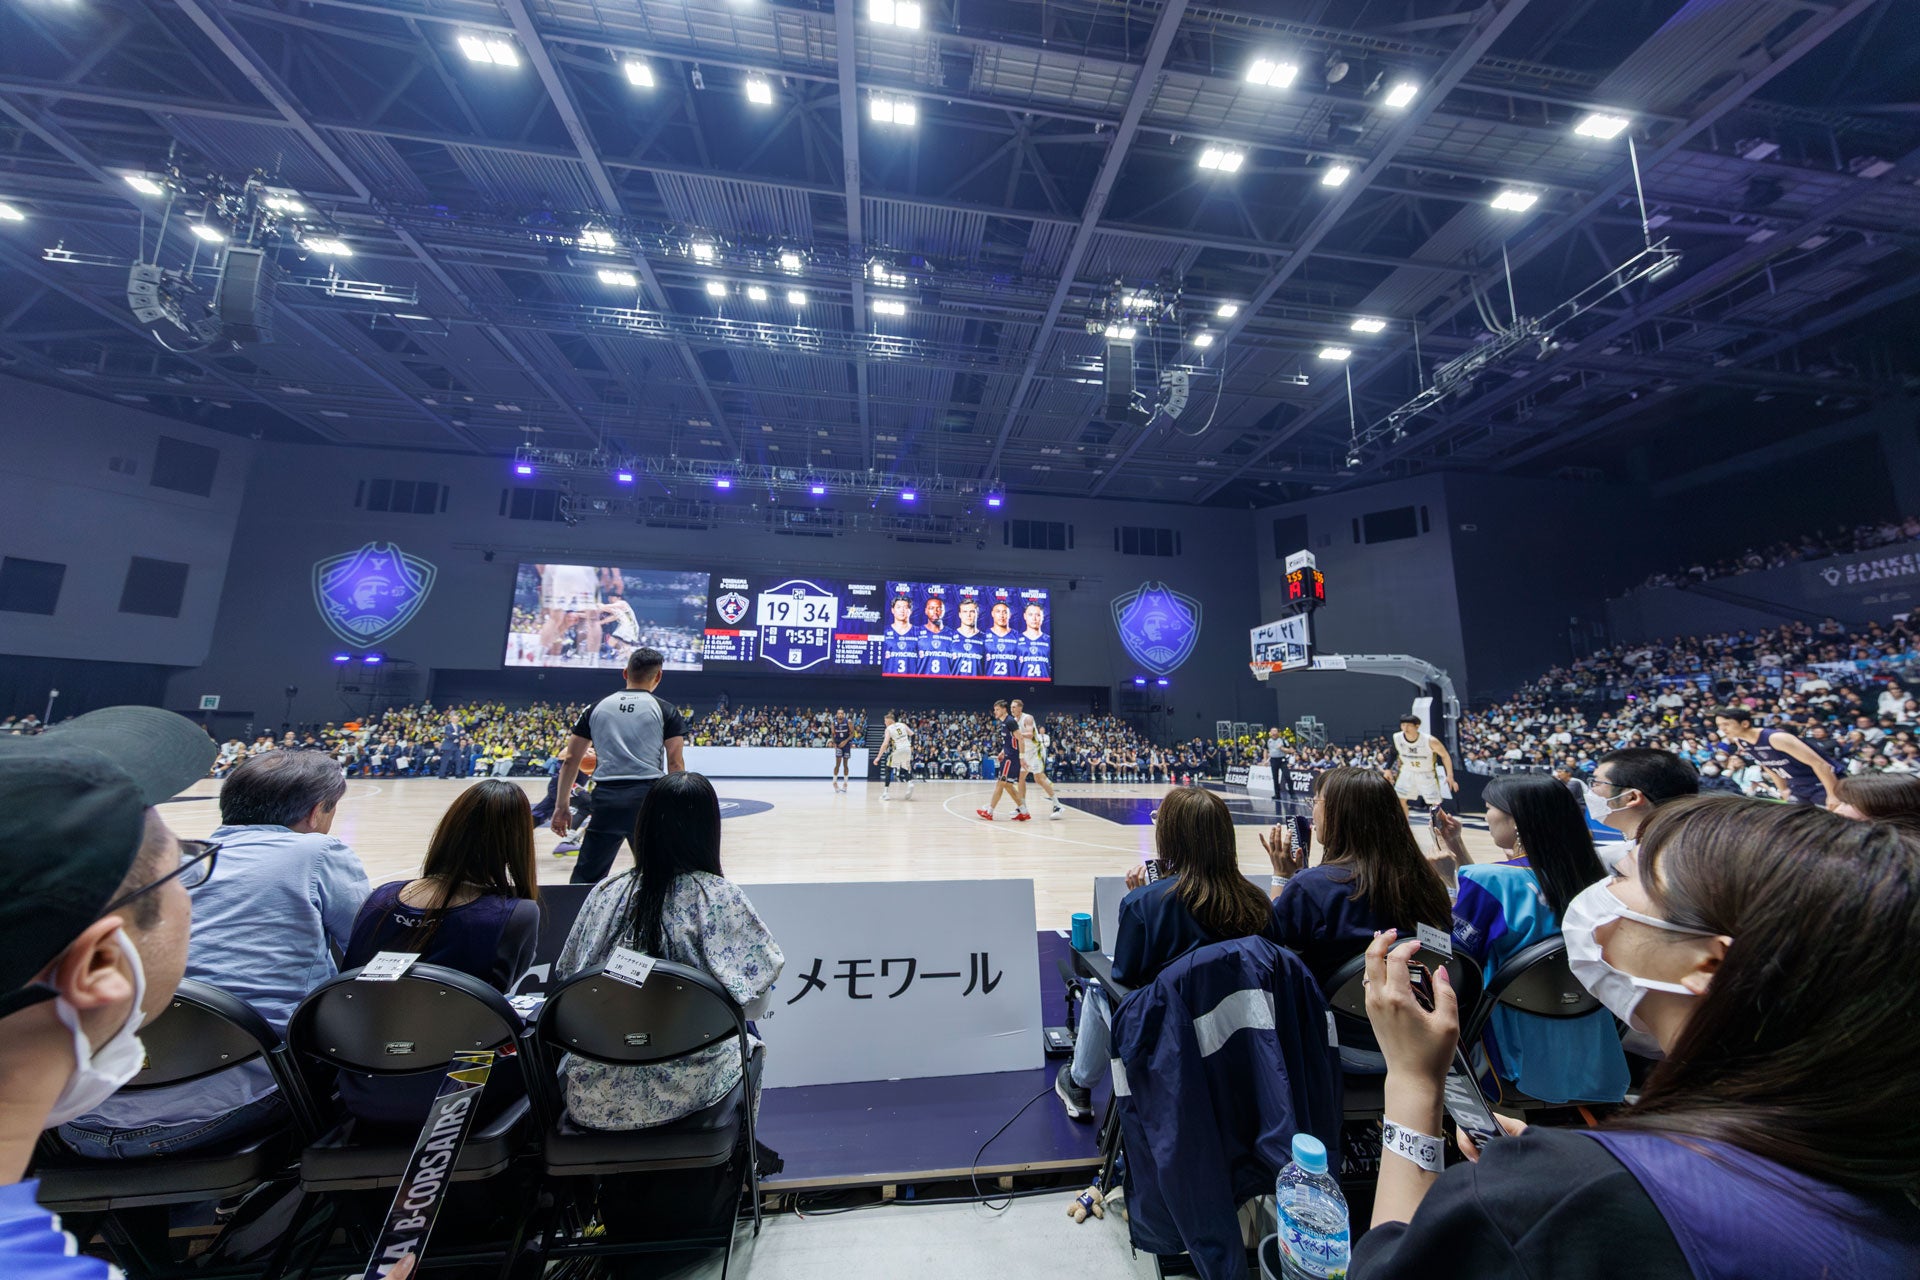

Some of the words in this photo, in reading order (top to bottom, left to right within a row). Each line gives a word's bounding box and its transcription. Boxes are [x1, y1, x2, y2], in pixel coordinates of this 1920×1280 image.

[767, 601, 790, 621] 19
[803, 602, 830, 622] 34
[786, 629, 814, 644] 7:55
[792, 653, 798, 662] 2
[898, 660, 906, 672] 3
[931, 660, 940, 673] 8
[960, 660, 972, 673] 21
[994, 662, 1007, 675] 23
[1027, 664, 1041, 677] 24
[619, 703, 635, 713] 46
[1293, 781, 1310, 792] LIVE
[787, 952, 1003, 1006] メモワール
[393, 1096, 471, 1231] B-CORSAIRS
